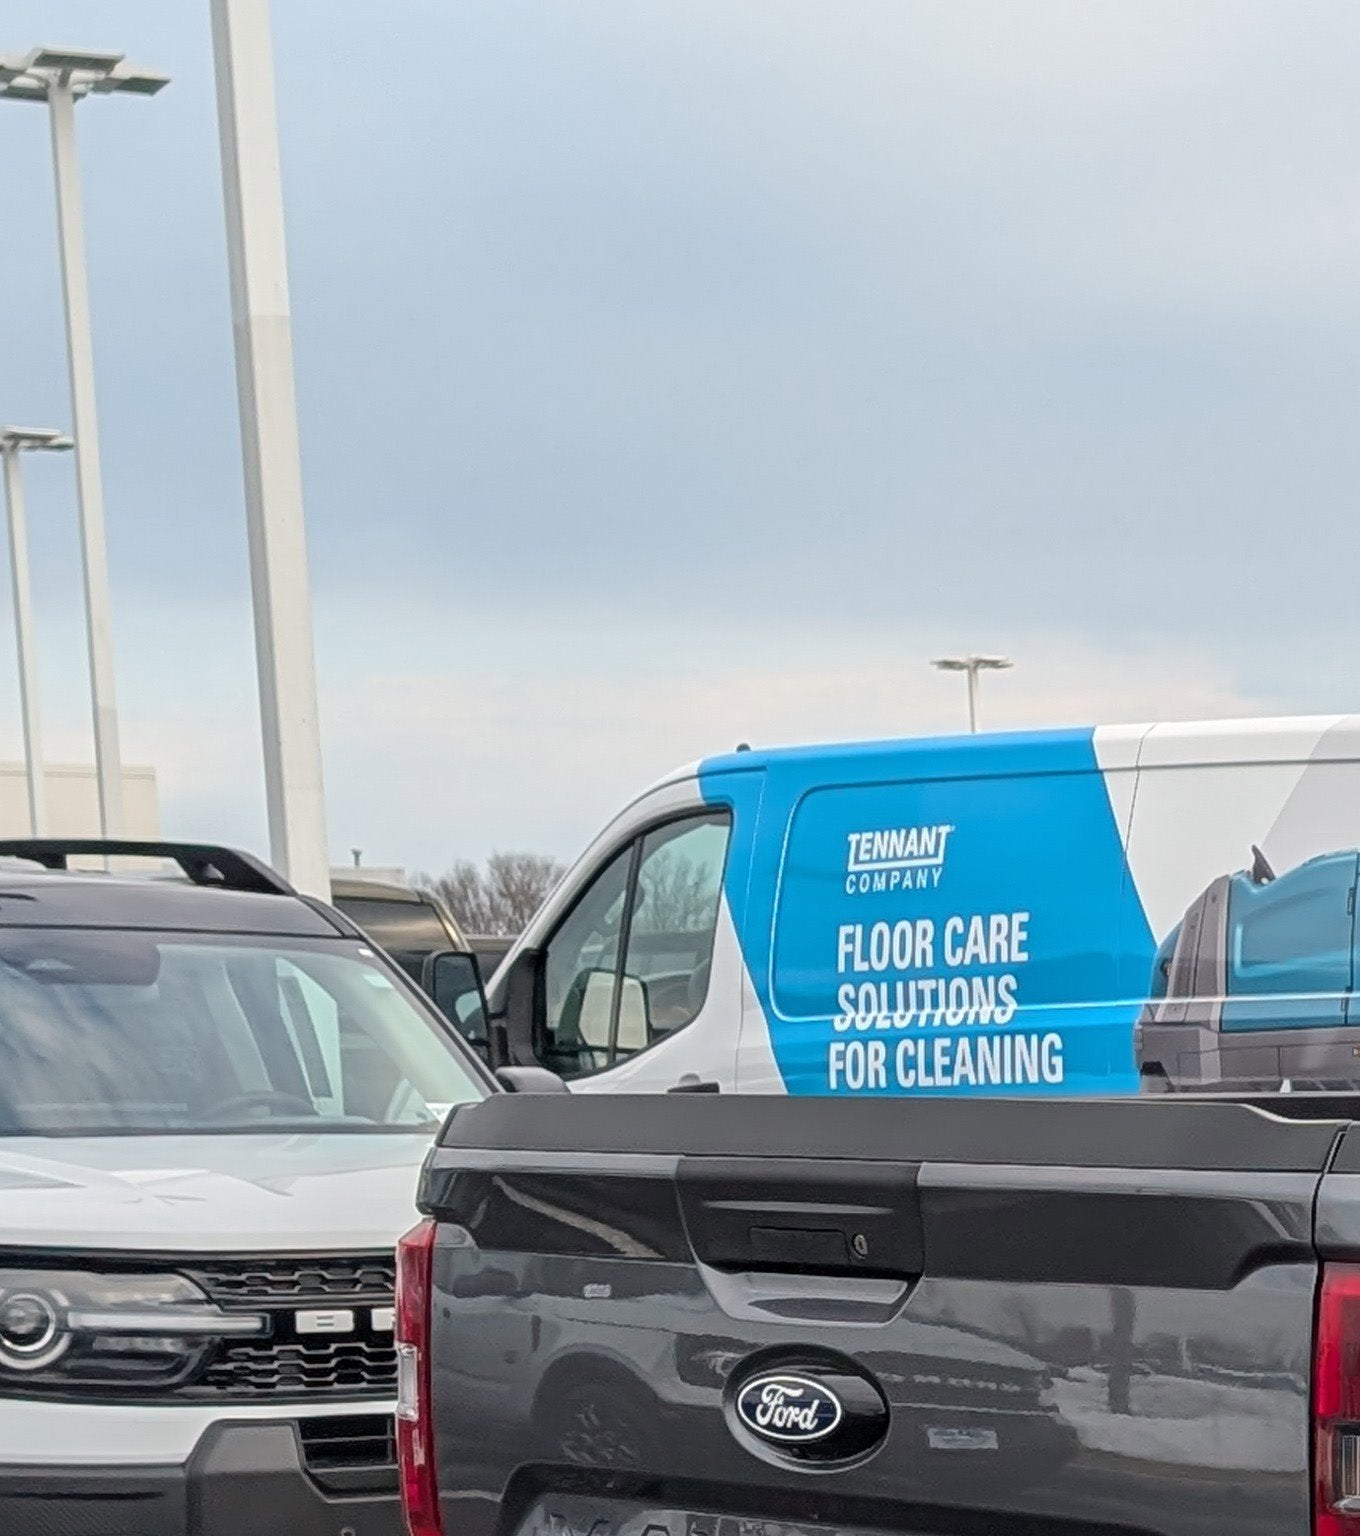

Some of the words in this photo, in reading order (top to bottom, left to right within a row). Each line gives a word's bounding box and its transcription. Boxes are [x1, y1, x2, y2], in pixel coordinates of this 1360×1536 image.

[847, 825, 955, 872] TENNANT
[845, 866, 943, 895] COMPANY
[837, 919, 934, 973] FLOOR
[944, 912, 1030, 967] CARE
[833, 974, 1019, 1032] SOLUTIONS
[828, 1039, 888, 1090] FOR
[895, 1032, 1064, 1088] CLEANING
[754, 1383, 821, 1431] Ford
